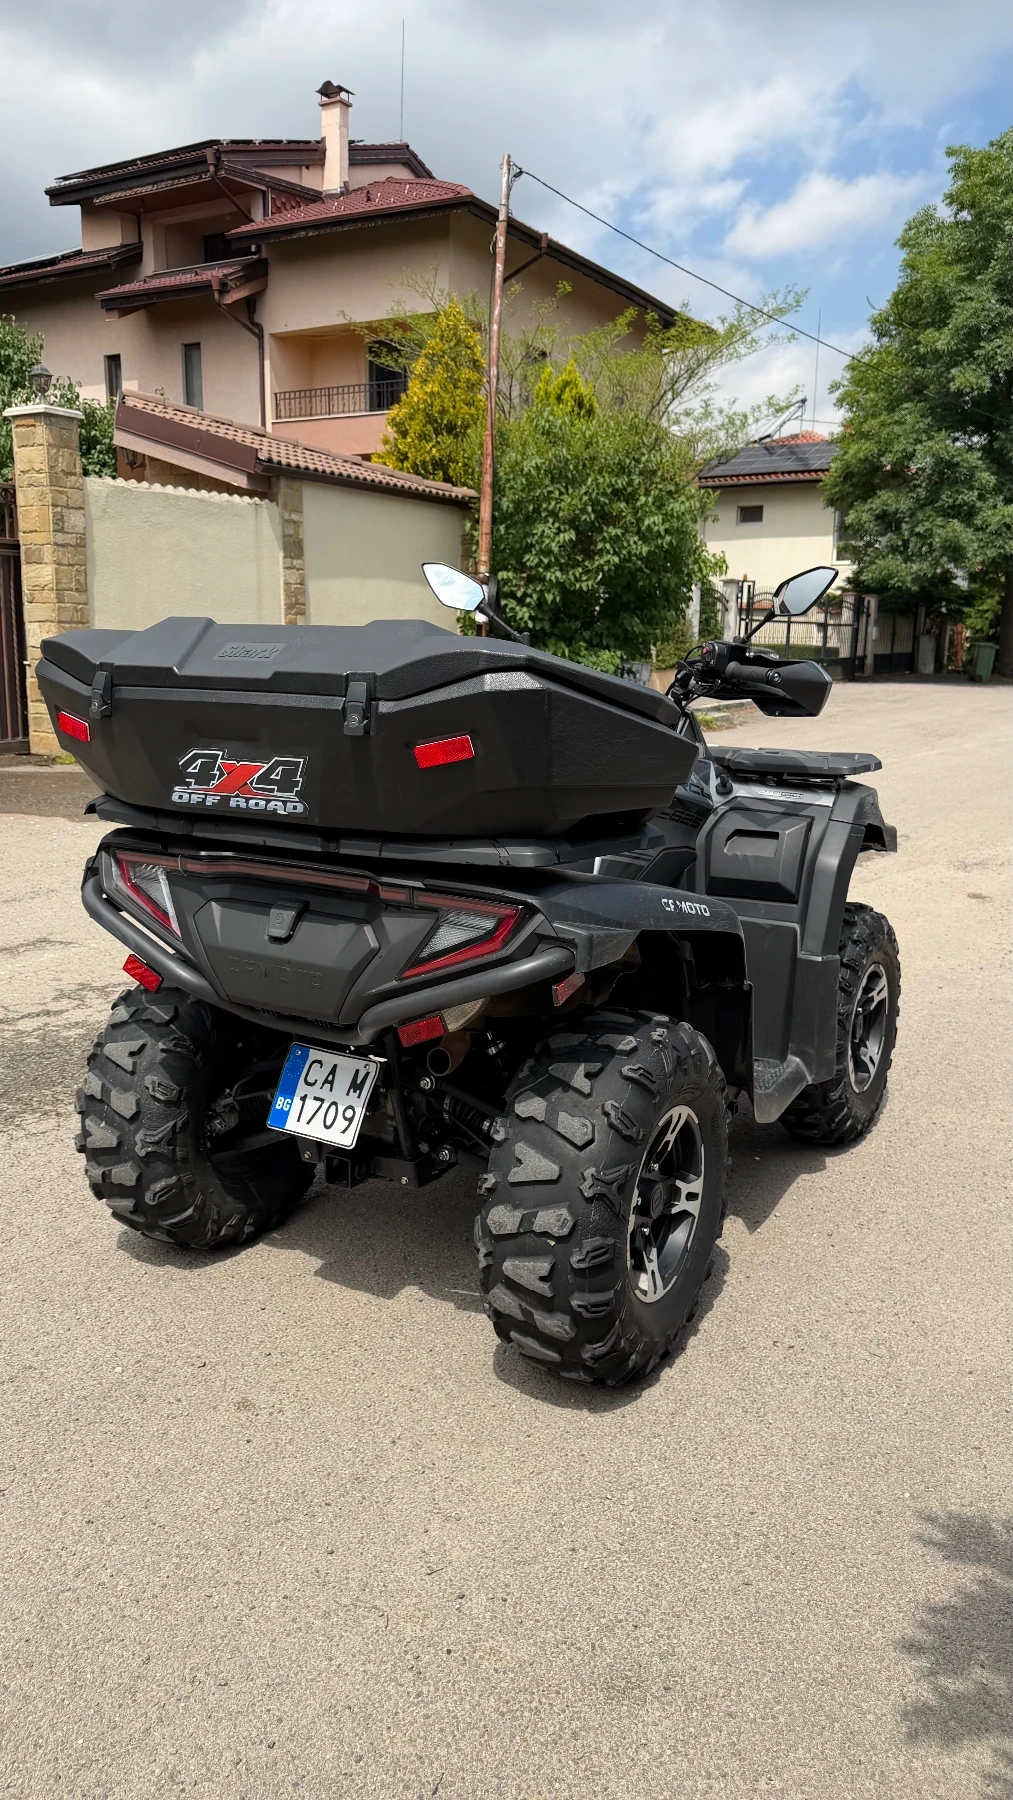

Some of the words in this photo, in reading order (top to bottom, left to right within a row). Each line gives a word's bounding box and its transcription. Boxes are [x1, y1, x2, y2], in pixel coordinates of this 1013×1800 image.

[171, 791, 221, 806] OFF
[229, 797, 304, 815] ROAD
[303, 1059, 335, 1093] CA
[346, 1069, 370, 1099] M
[275, 1096, 292, 1112] BG
[296, 1094, 356, 1135] 1709
